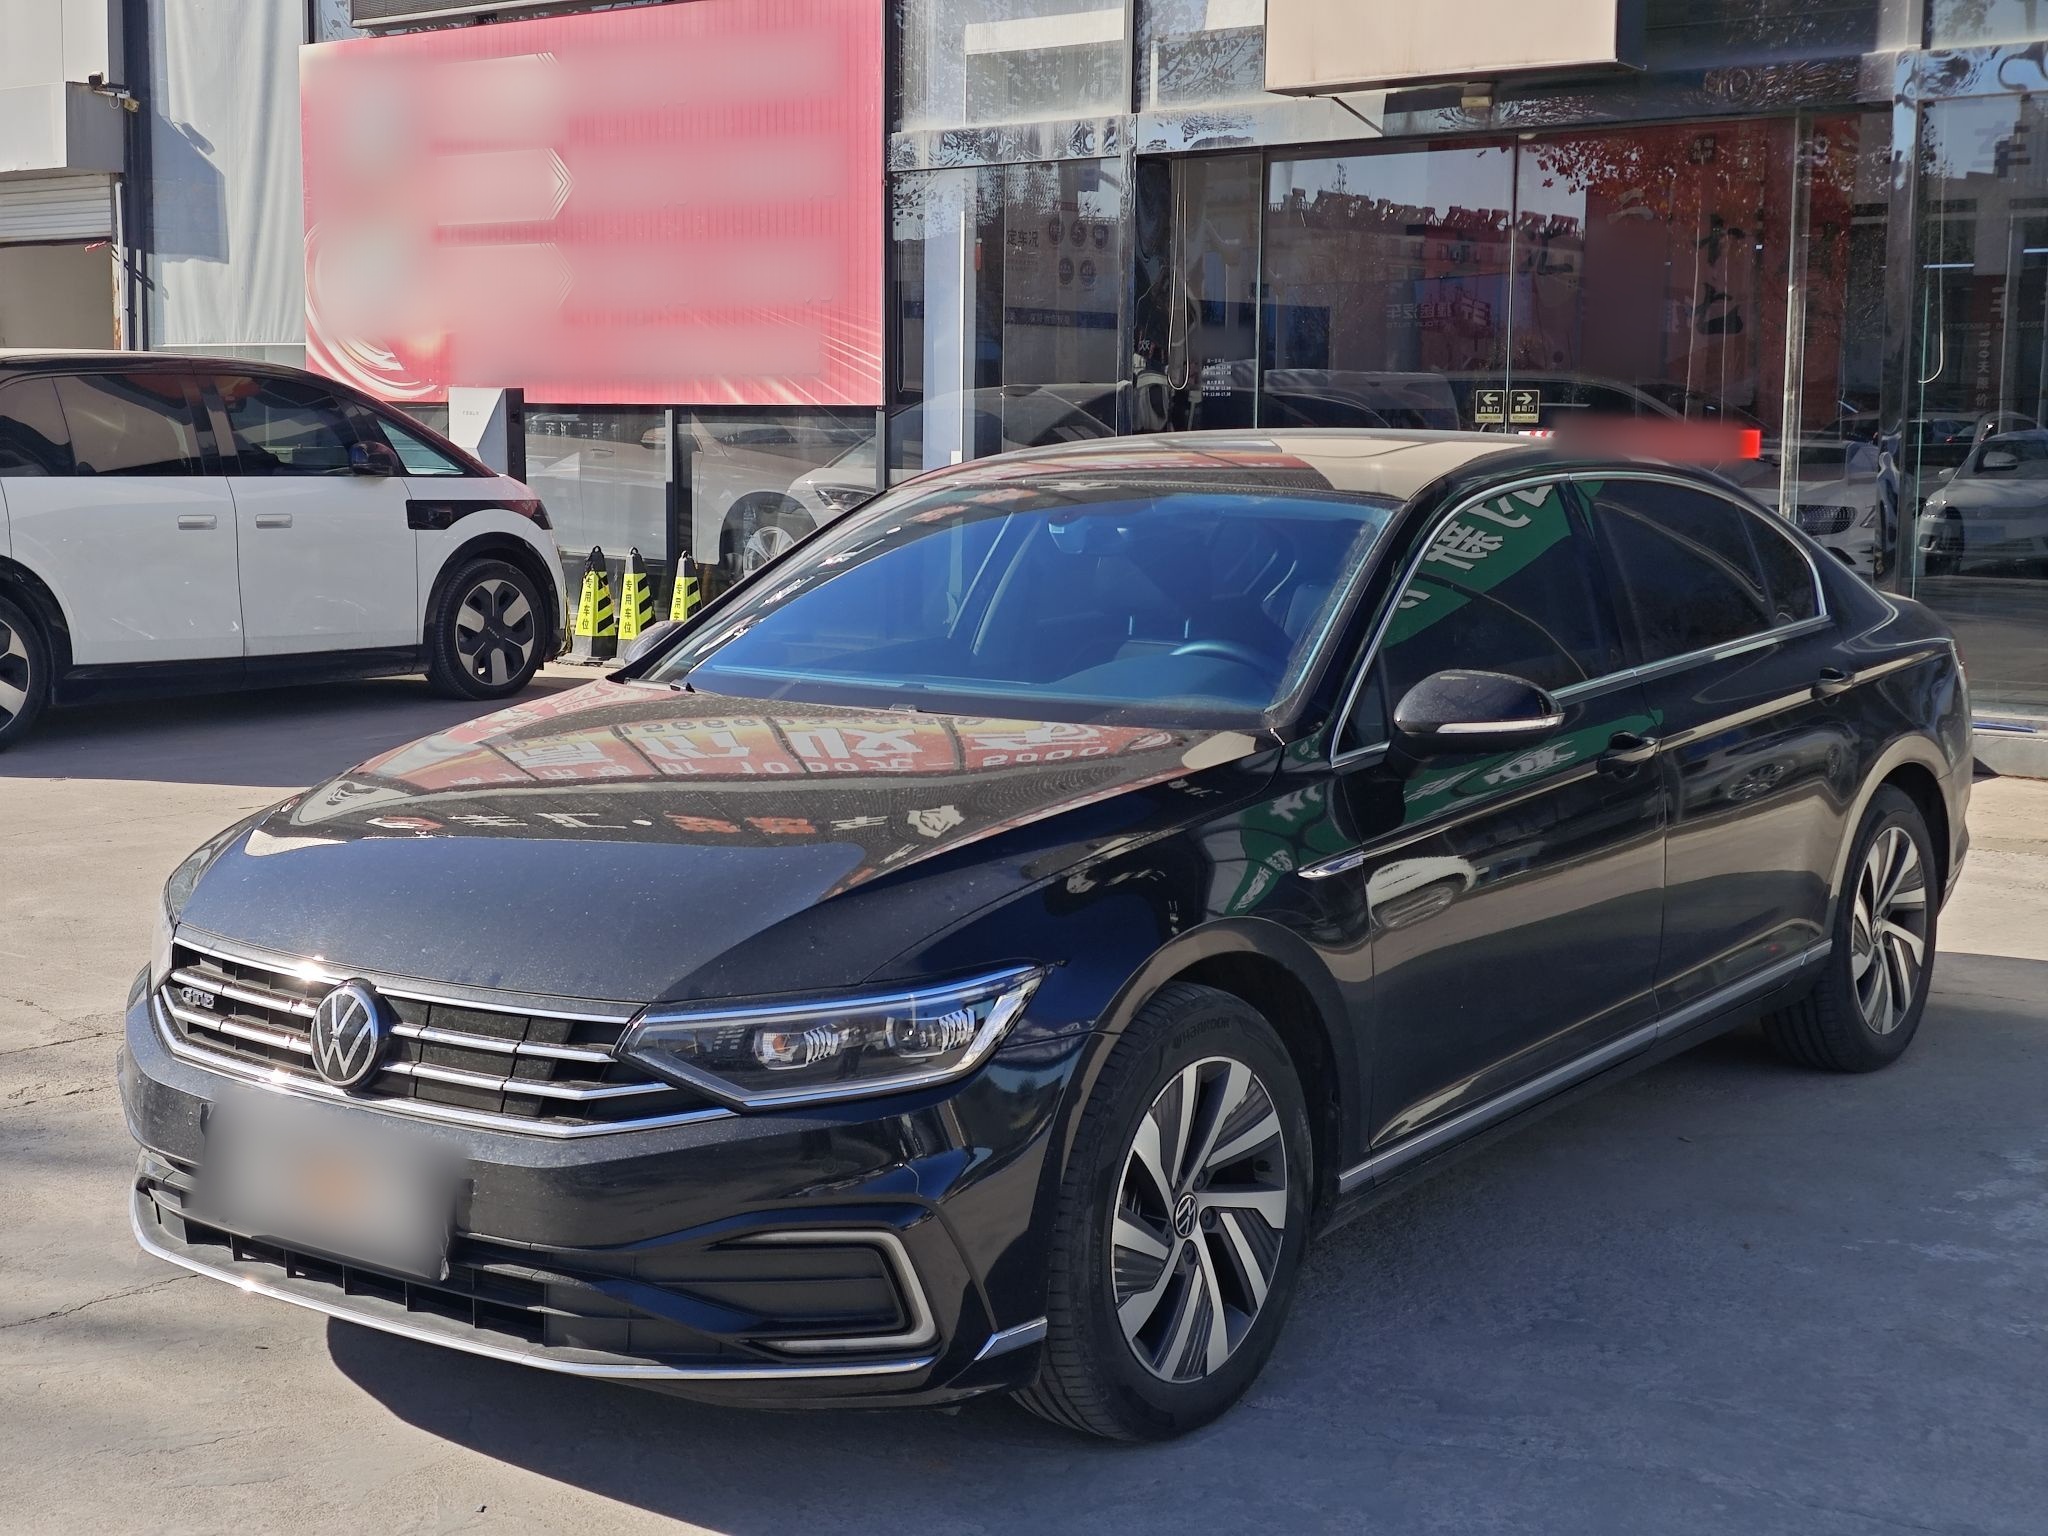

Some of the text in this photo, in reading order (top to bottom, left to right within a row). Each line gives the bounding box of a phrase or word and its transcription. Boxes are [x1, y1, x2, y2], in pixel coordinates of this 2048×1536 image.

[1480, 405, 1500, 413] 自动门
[581, 576, 593, 631] 专用车位
[623, 579, 633, 633] 专用车位
